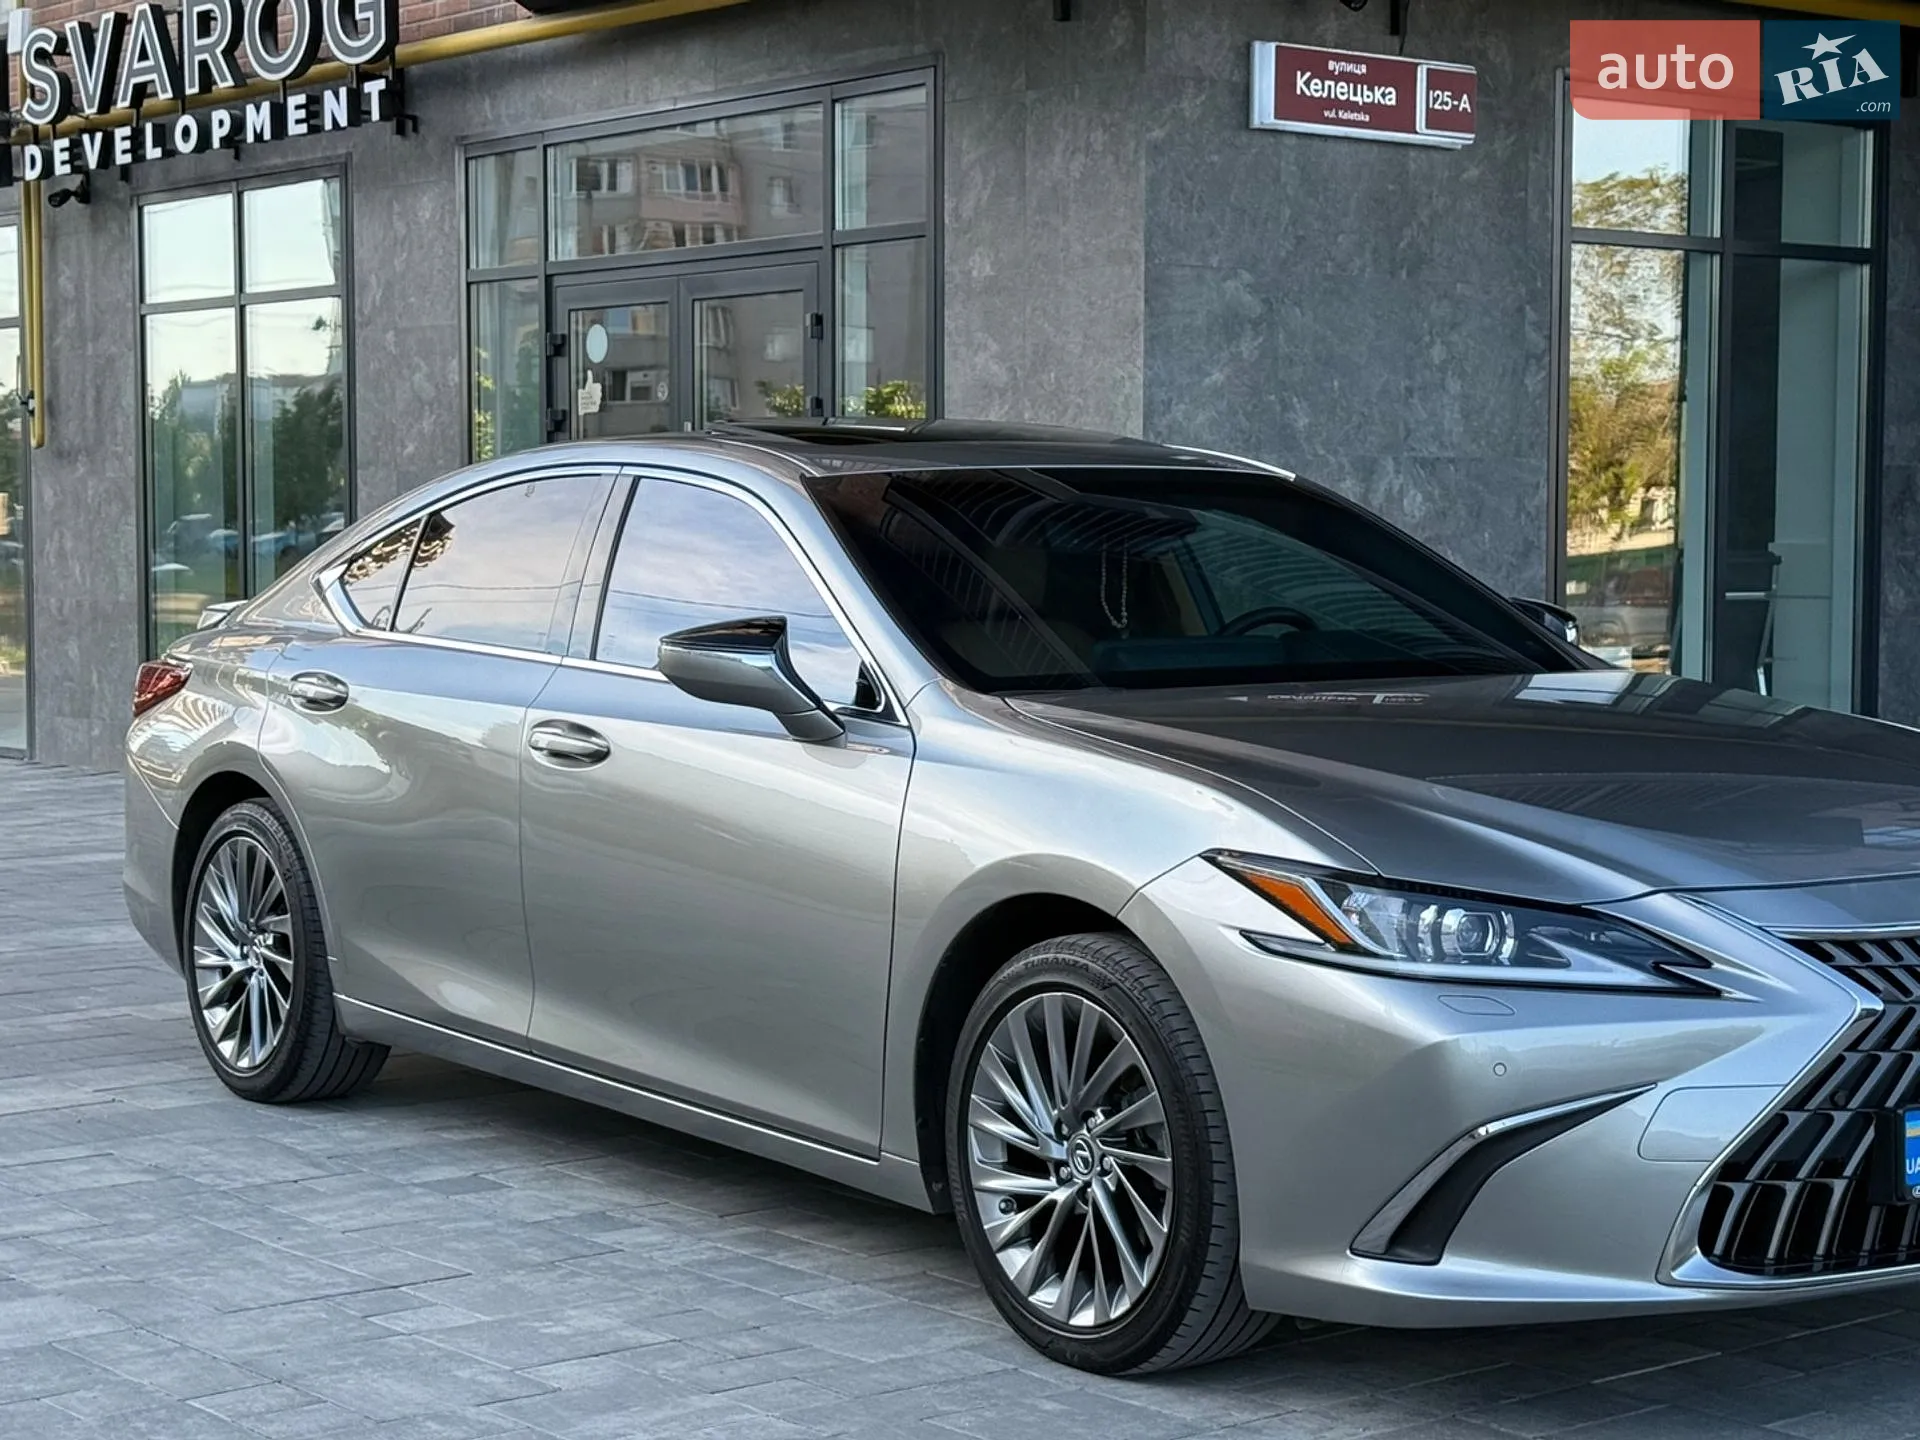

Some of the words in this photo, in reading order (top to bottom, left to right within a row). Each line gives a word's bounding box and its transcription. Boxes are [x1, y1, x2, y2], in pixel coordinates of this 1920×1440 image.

[22, 0, 392, 126] SVAROG
[1328, 59, 1367, 75] вулиця
[1296, 70, 1397, 106] Келецька
[1338, 109, 1370, 122] Keletska
[24, 78, 387, 182] DEVELOPMENT
[1024, 957, 1090, 973] TURANZA
